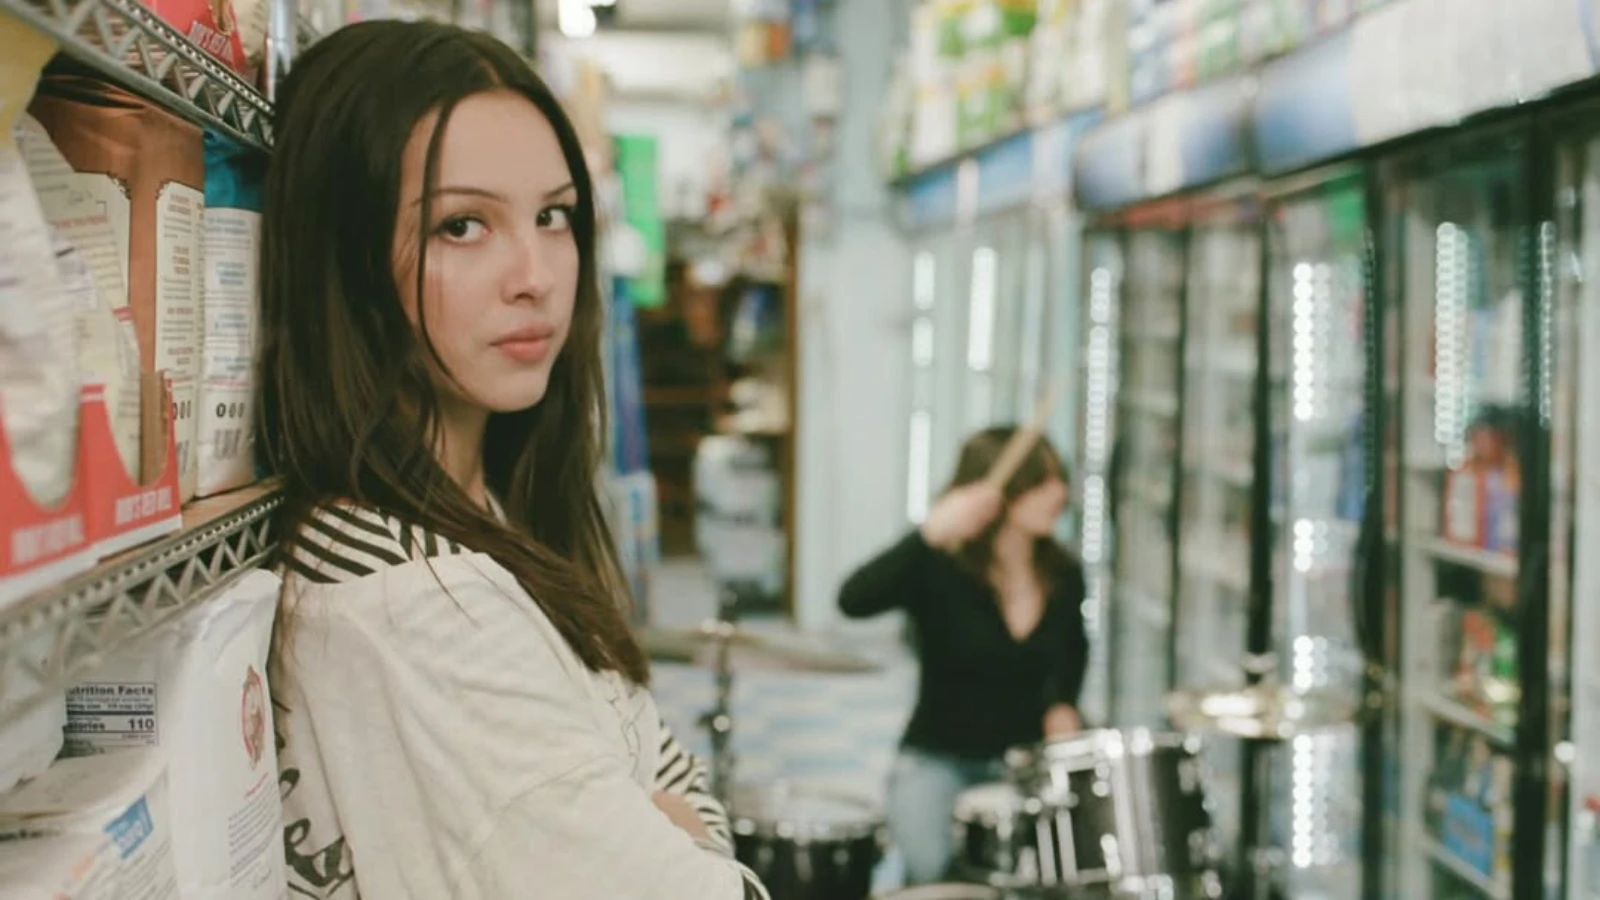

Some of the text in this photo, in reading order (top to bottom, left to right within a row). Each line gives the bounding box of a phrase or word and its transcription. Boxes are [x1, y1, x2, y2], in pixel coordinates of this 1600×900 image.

[67, 685, 154, 696] utrition Facts
[67, 718, 155, 731] alories 110
